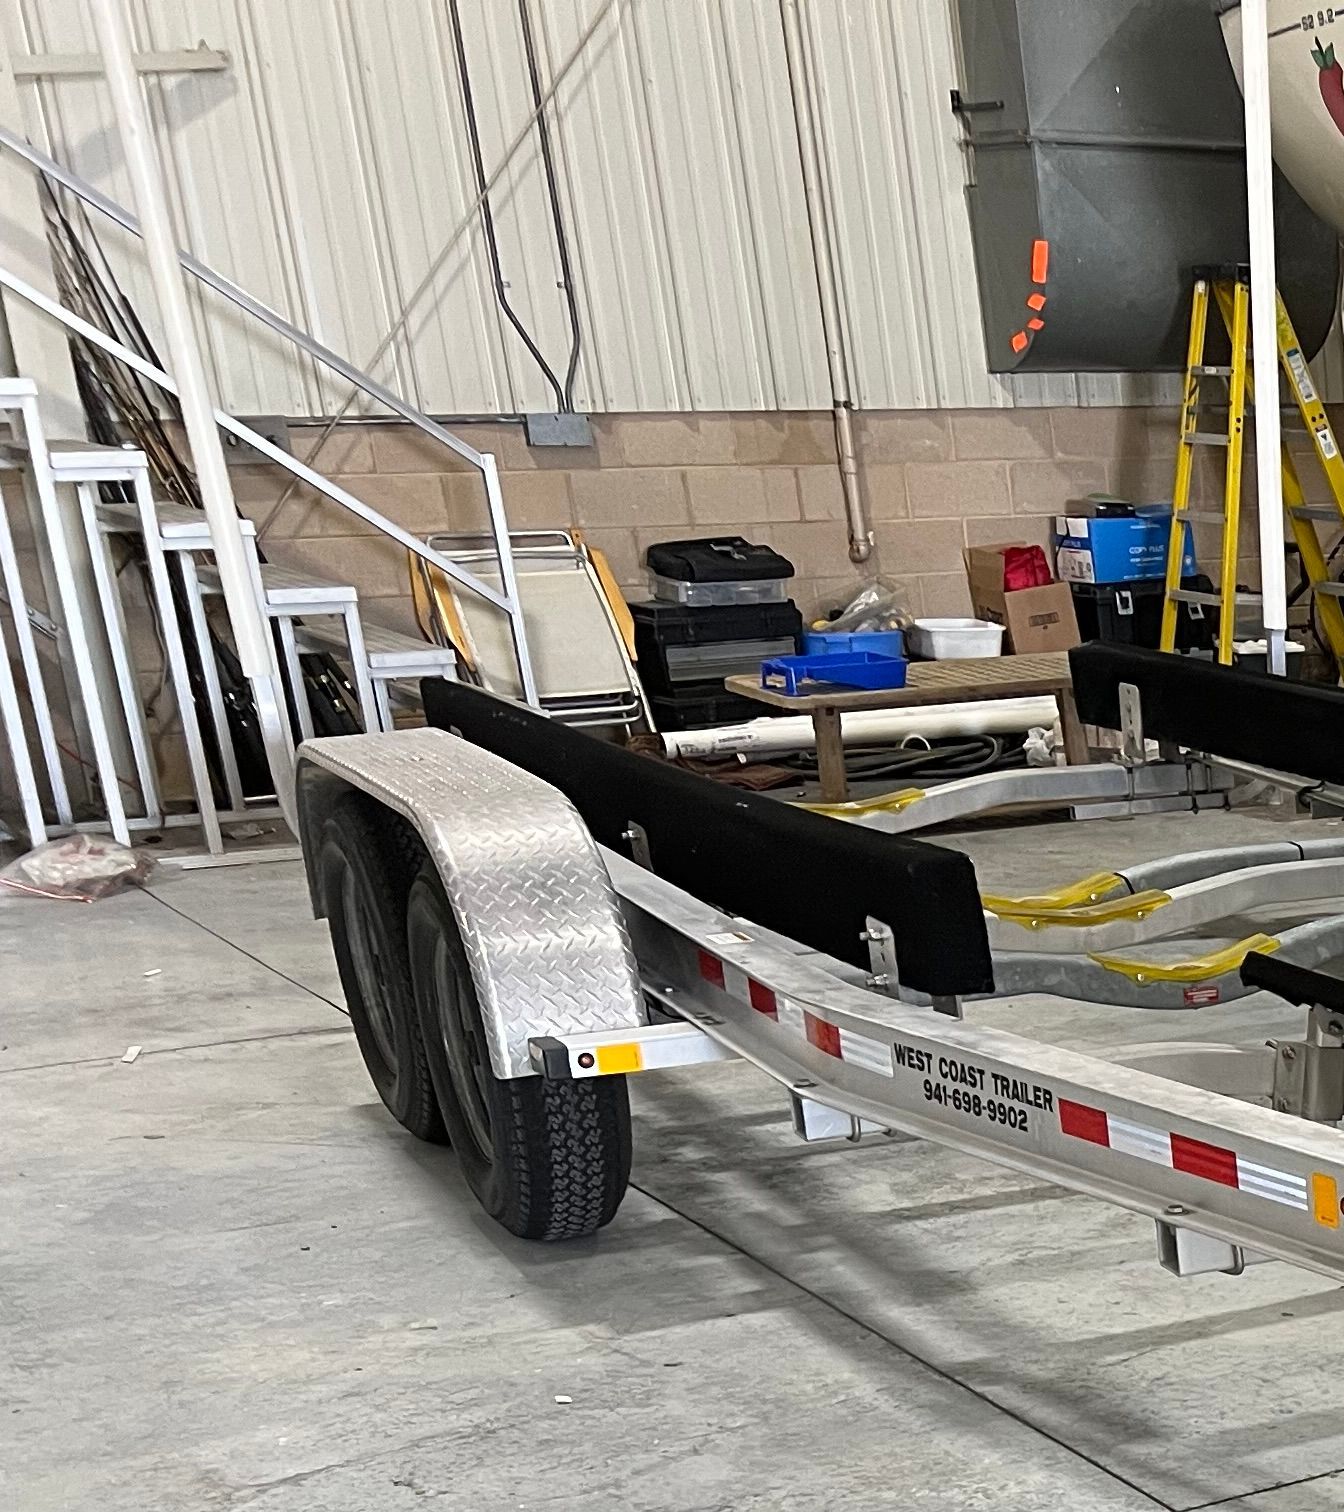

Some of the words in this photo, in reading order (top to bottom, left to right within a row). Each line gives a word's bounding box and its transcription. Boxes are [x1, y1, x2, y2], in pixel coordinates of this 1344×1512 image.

[894, 1042, 933, 1074] WEST
[938, 1057, 985, 1090] COAST
[991, 1072, 1054, 1112] TRAILER
[923, 1079, 1029, 1132] 941-698-9902
